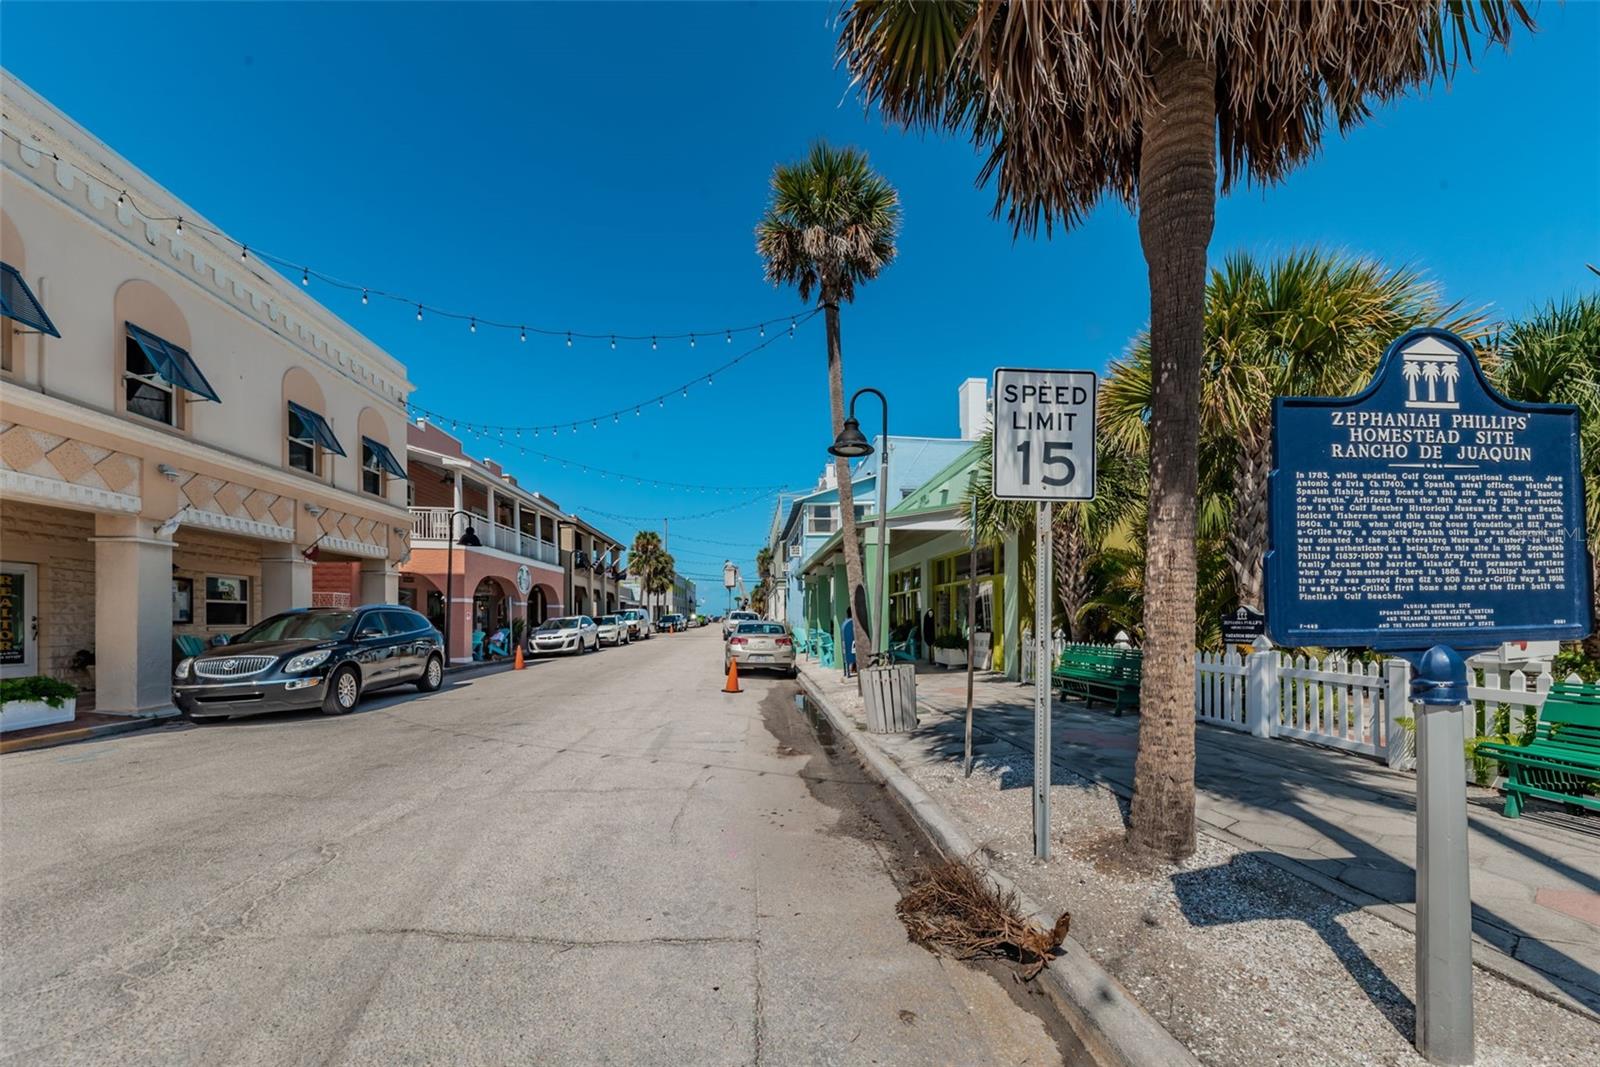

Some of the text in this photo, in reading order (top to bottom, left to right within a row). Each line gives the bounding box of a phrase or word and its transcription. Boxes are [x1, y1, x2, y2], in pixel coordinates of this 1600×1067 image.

[1004, 384, 1087, 405] SPEED
[1012, 412, 1078, 432] LIMIT
[1332, 412, 1532, 430] ZEPHANIAH PHILLIPS'
[1350, 428, 1514, 445] HOMESTEAD SITE
[1331, 444, 1532, 462] RANCHO DE JUAQUIN
[1016, 440, 1076, 486] 15
[1361, 472, 1397, 481] updating
[1424, 481, 1455, 489] Spanish
[1296, 487, 1329, 496] Spanish
[1334, 488, 1364, 497] fishing
[1393, 521, 1424, 529] digging
[1474, 528, 1486, 537] jar
[1401, 536, 1446, 545] Petersburg
[1406, 544, 1428, 553] being
[1297, 561, 1325, 569] family
